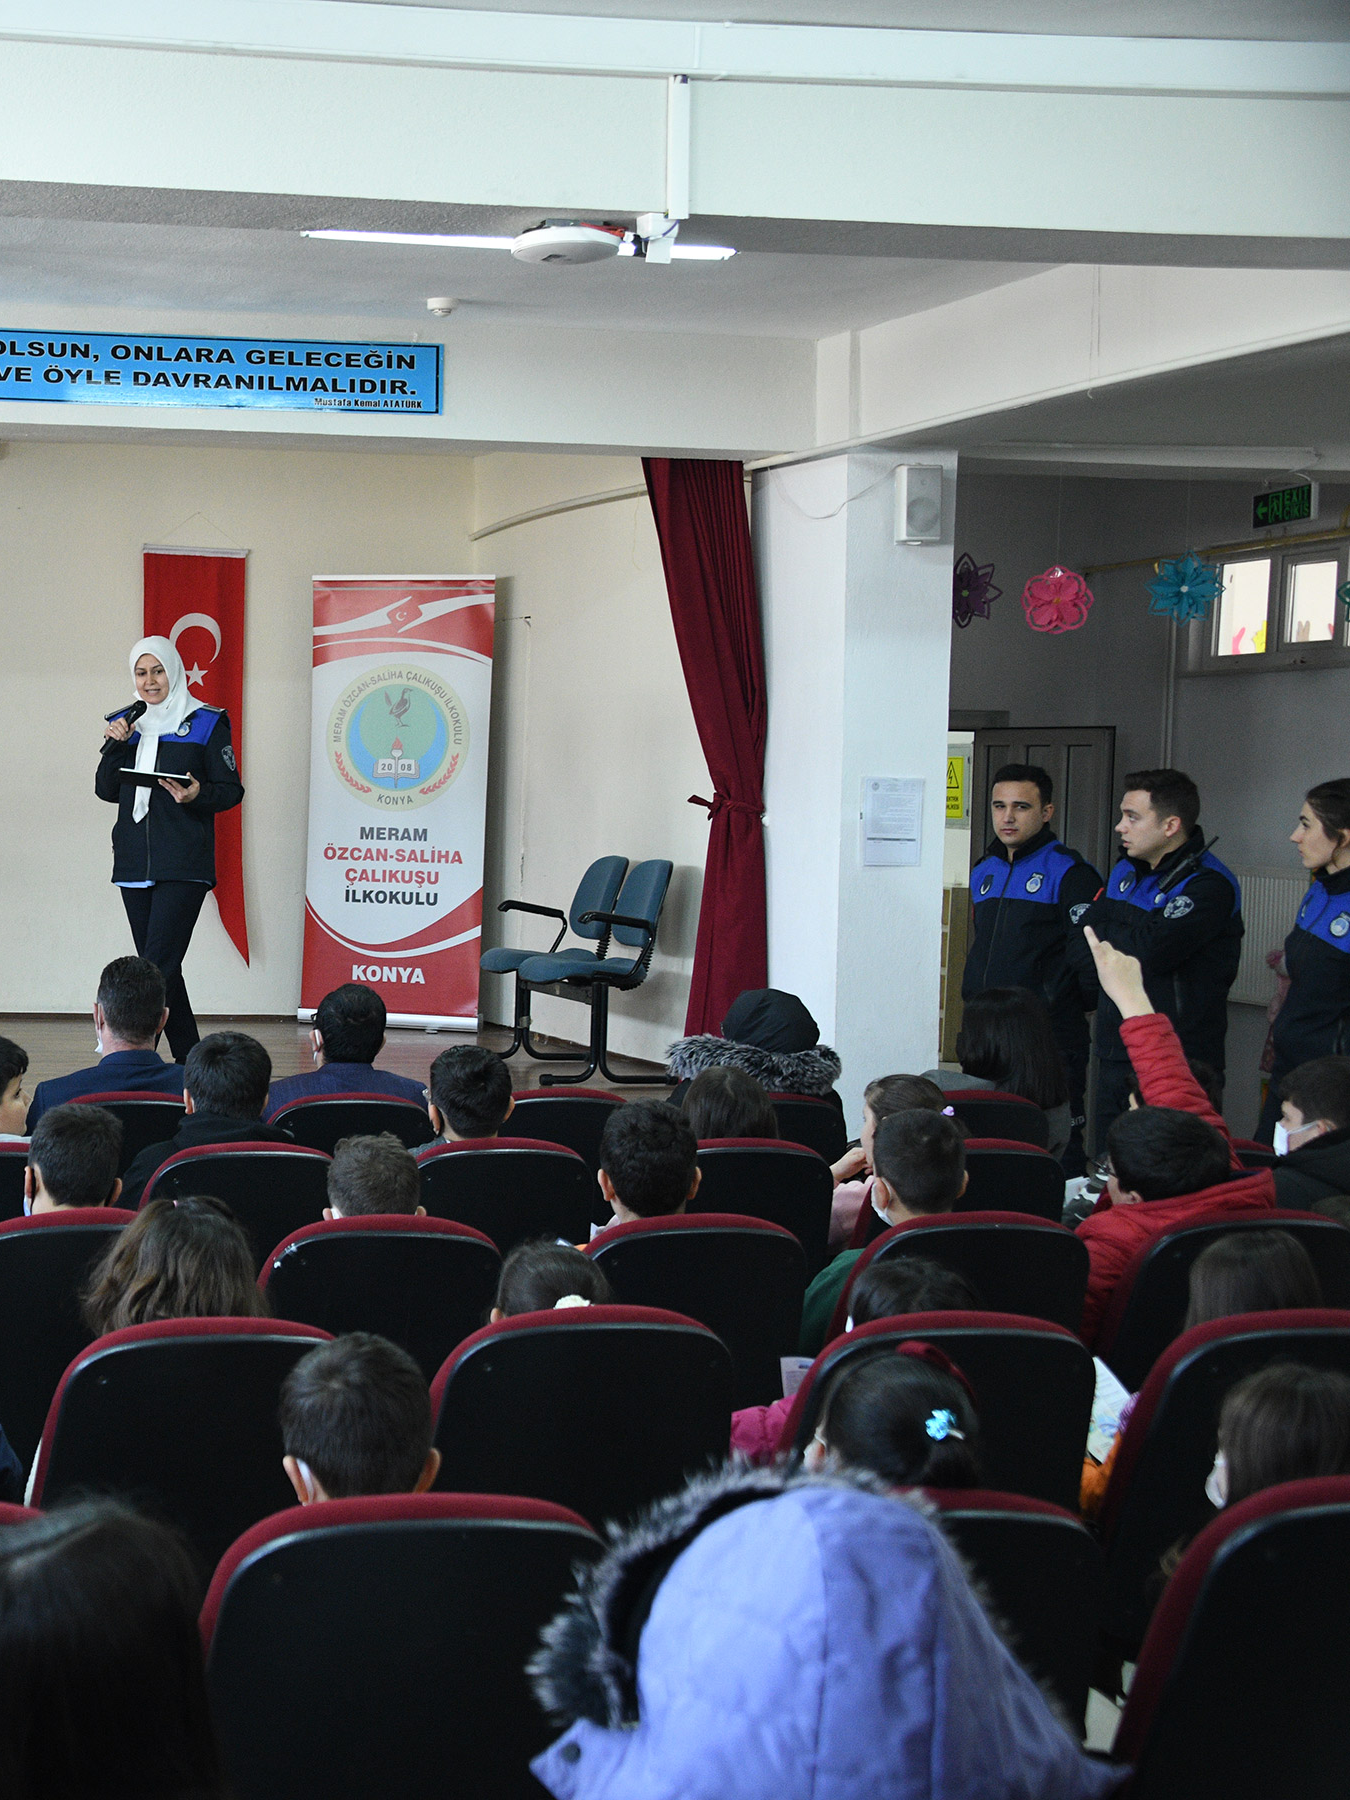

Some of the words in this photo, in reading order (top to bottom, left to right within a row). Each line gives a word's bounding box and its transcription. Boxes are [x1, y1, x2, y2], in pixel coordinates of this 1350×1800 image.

[110, 344, 236, 364] ONLARA
[245, 350, 416, 370] GELECEĞİN
[43, 364, 122, 386] ÖYLE
[133, 371, 417, 396] DAVRANILMALIDIR.
[314, 397, 352, 407] Mustafa
[354, 398, 381, 408] Kemal
[382, 399, 423, 409] ATATÜRK
[1284, 485, 1310, 504] EXIT
[333, 708, 348, 743] MERAM
[345, 668, 404, 708] ÖZCAN-SALİHA
[405, 671, 447, 700] ÇALIKUŞU
[444, 695, 463, 745] İLKOKULU
[381, 763, 393, 771] 20
[400, 763, 412, 771] 08
[376, 793, 414, 806] KONYA
[359, 826, 428, 842] MERAM
[323, 843, 464, 865] ÖZCAN-SALİHA
[345, 868, 440, 888] ÇALIKUŞU
[344, 885, 439, 906] İLKOKULU
[351, 964, 426, 984] KONYA
